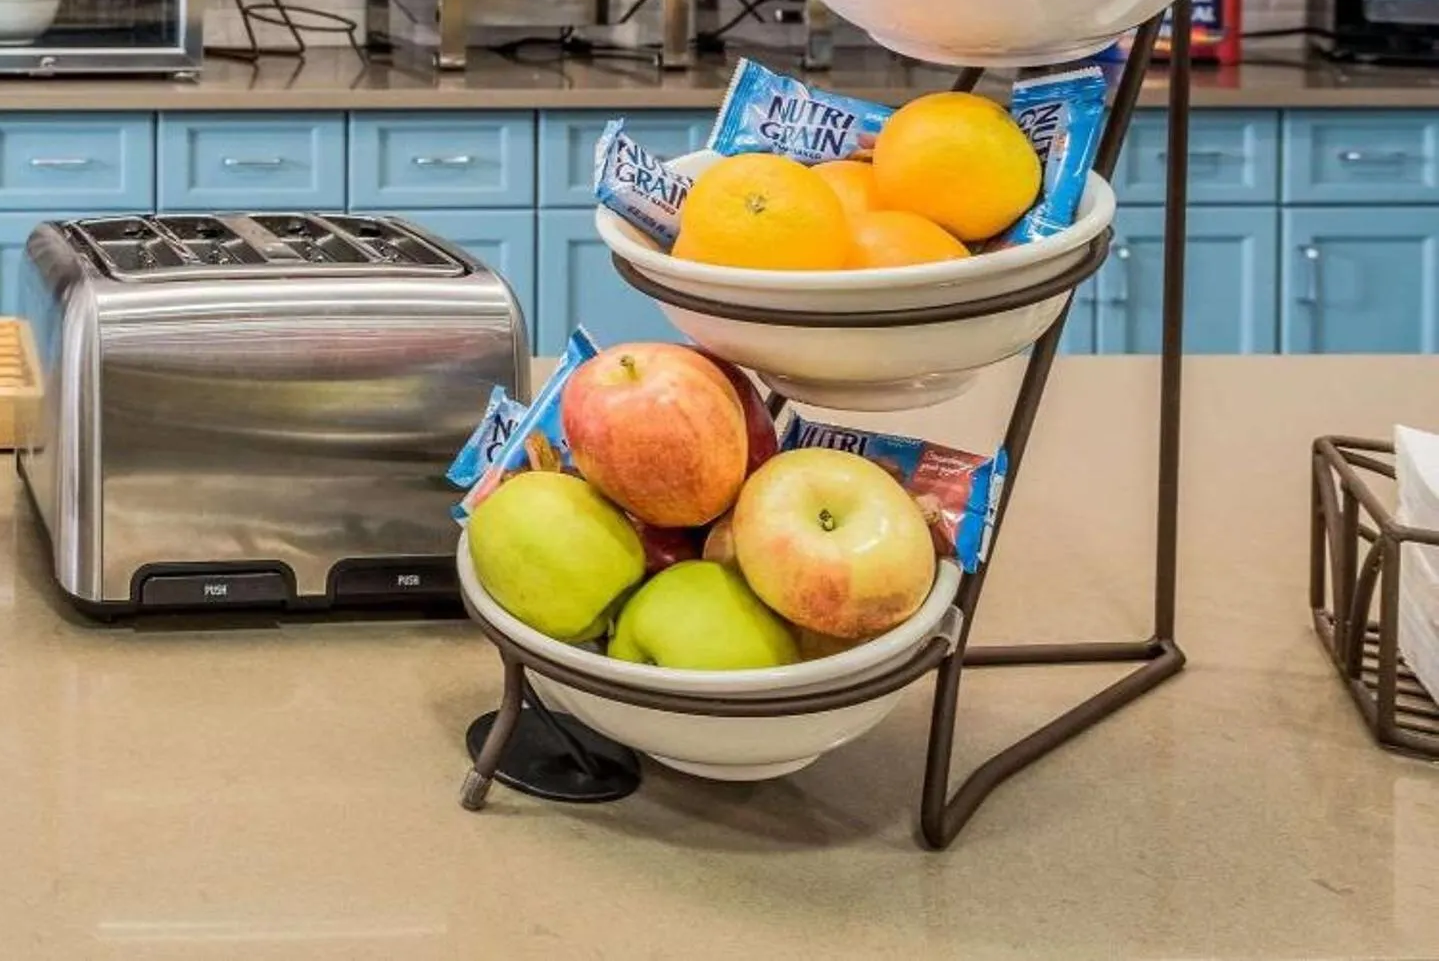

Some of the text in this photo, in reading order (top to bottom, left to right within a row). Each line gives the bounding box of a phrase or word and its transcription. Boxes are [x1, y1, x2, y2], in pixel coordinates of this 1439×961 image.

[768, 95, 855, 130] NUTRI
[759, 121, 847, 157] GRAIN
[204, 584, 229, 596] PUSH
[397, 574, 421, 586] PUSH
